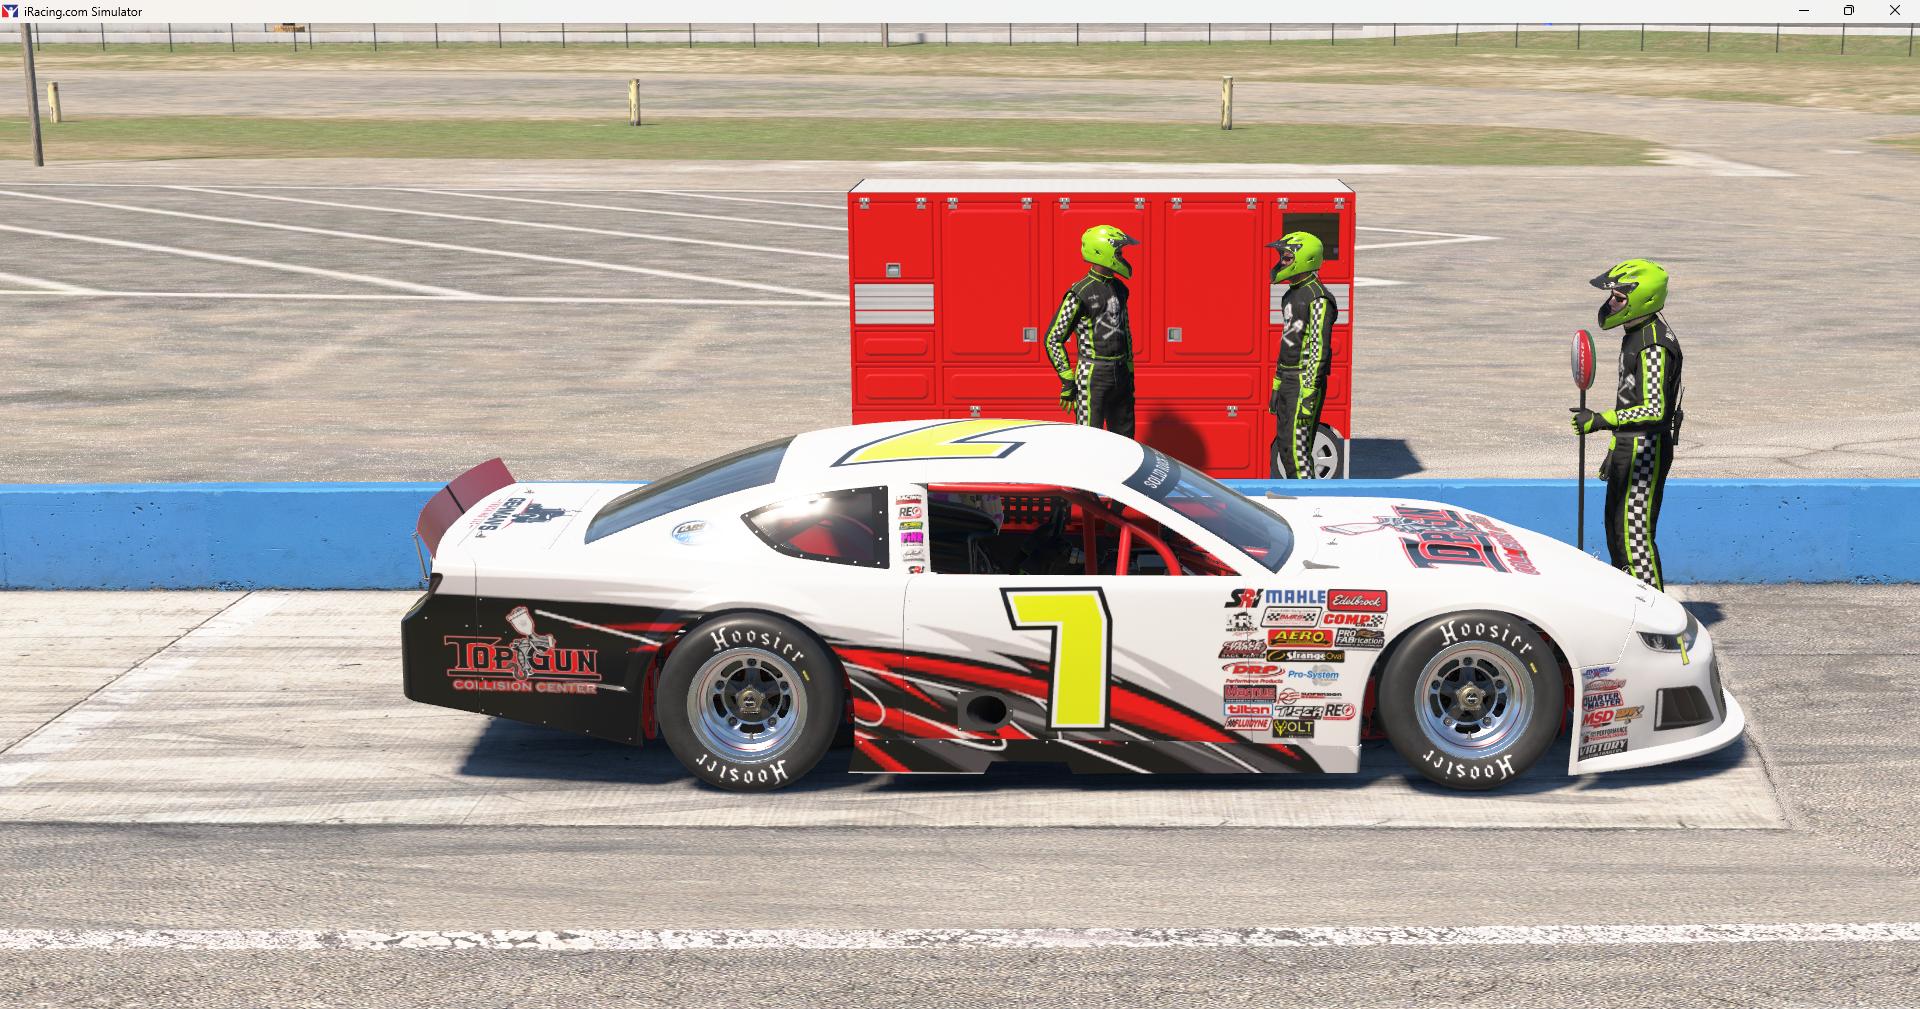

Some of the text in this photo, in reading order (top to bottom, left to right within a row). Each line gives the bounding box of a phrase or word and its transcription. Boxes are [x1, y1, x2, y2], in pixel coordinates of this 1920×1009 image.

[24, 6, 143, 18] iRacing.com Simulator
[1144, 468, 1168, 489] SOLID
[1265, 589, 1326, 604] MAHLE
[1332, 594, 1382, 607] Edelbrock
[1323, 613, 1371, 625] COMP
[1275, 630, 1325, 643] AERO
[1338, 629, 1357, 637] PRO
[1440, 620, 1533, 654] Hoosier
[710, 627, 805, 662] Hoosier
[1336, 636, 1384, 644] FABrication
[444, 635, 598, 673] TOP GUN
[1286, 650, 1326, 661] Strange
[1232, 665, 1278, 674] DRP
[1288, 670, 1339, 680] Pro-System
[453, 679, 598, 694] COLLISION CENTER
[1584, 692, 1619, 704] QUARTER
[1588, 698, 1620, 710] MASTER
[1227, 705, 1270, 714] tilton
[1275, 705, 1324, 718] TIGER
[1234, 718, 1268, 728] FLUIDYNE
[1583, 710, 1615, 726] MSD
[1579, 741, 1626, 756] VICTORY
[695, 754, 790, 785] Hoosier
[1423, 750, 1516, 780] Hoosier
